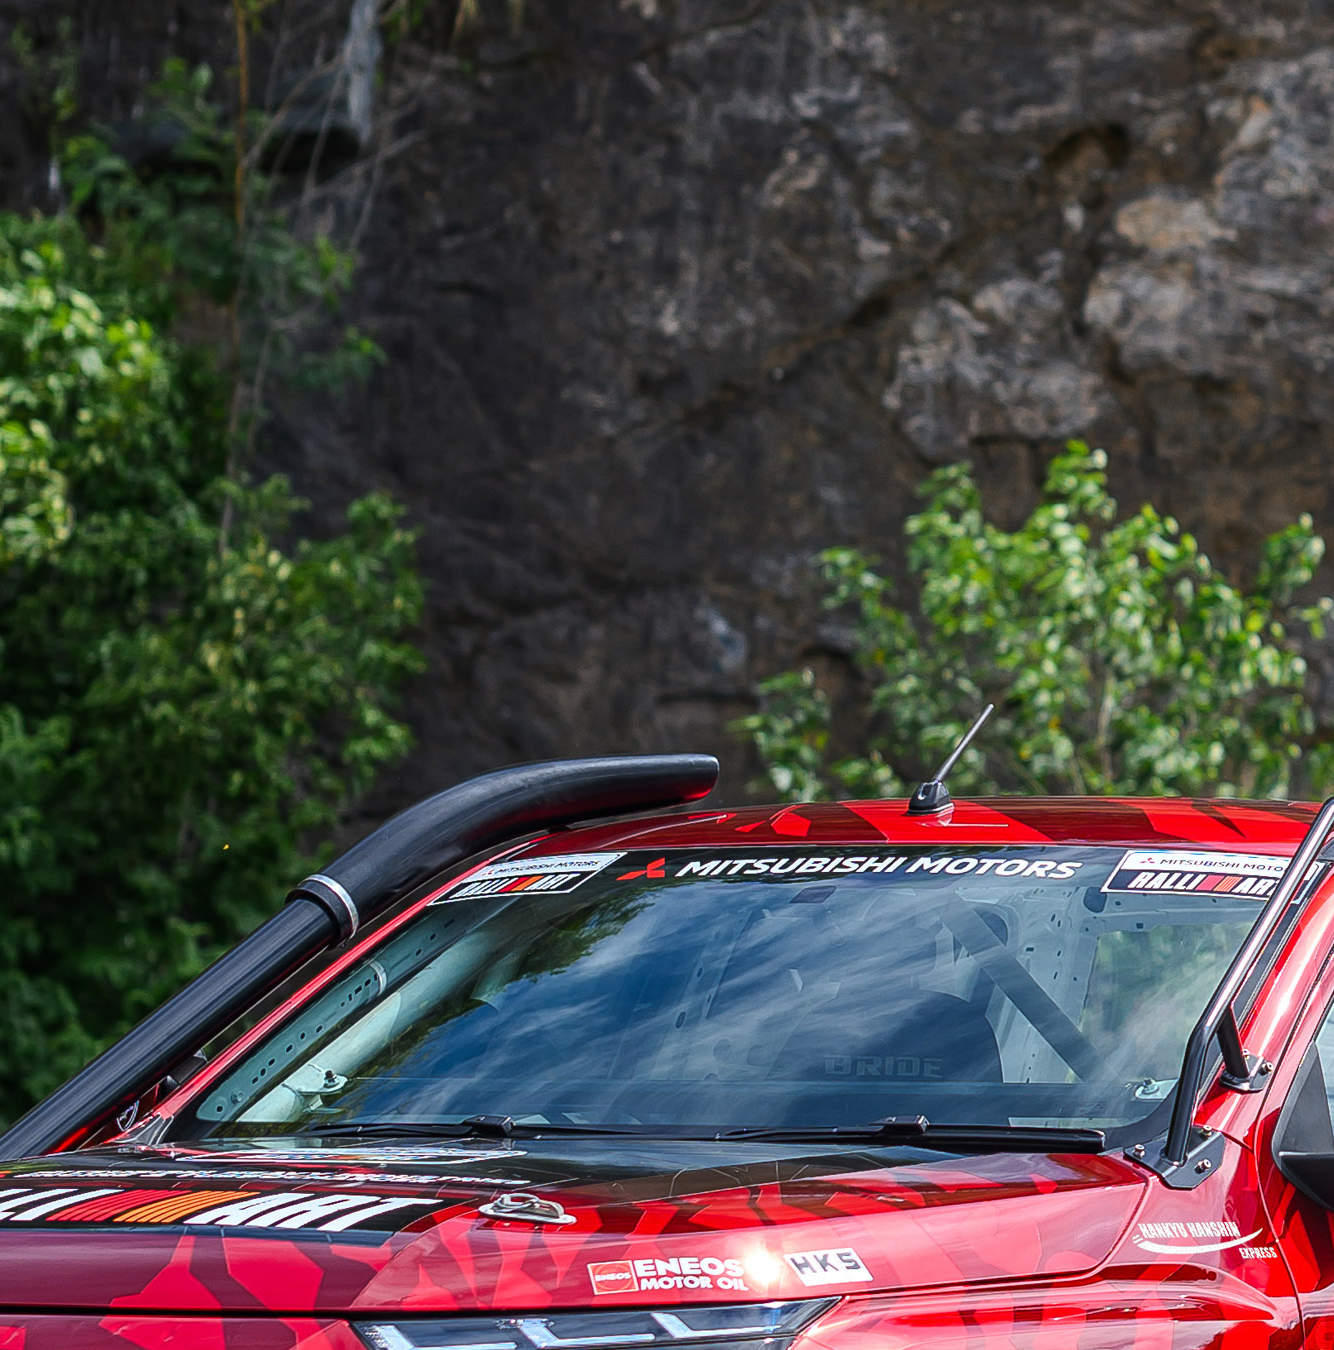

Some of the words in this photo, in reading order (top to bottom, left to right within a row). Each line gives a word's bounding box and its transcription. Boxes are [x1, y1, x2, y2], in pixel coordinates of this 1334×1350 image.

[553, 860, 601, 871] MOTORS
[675, 857, 909, 877] MITSUBISHI
[906, 857, 1083, 879] MOTORS
[1159, 858, 1240, 869] MITSUBISHI
[1242, 864, 1286, 873] MOTO
[823, 1053, 944, 1079] BRIDE
[1138, 1223, 1188, 1239] HANKYU
[1186, 1221, 1241, 1237] HANSHIN
[1239, 1247, 1278, 1259] EXPRESS
[632, 1257, 744, 1279] ENEOS
[787, 1249, 866, 1277] HKS
[594, 1272, 632, 1282] ENEOS
[640, 1275, 713, 1291] MOTOR
[716, 1277, 749, 1292] OIL
